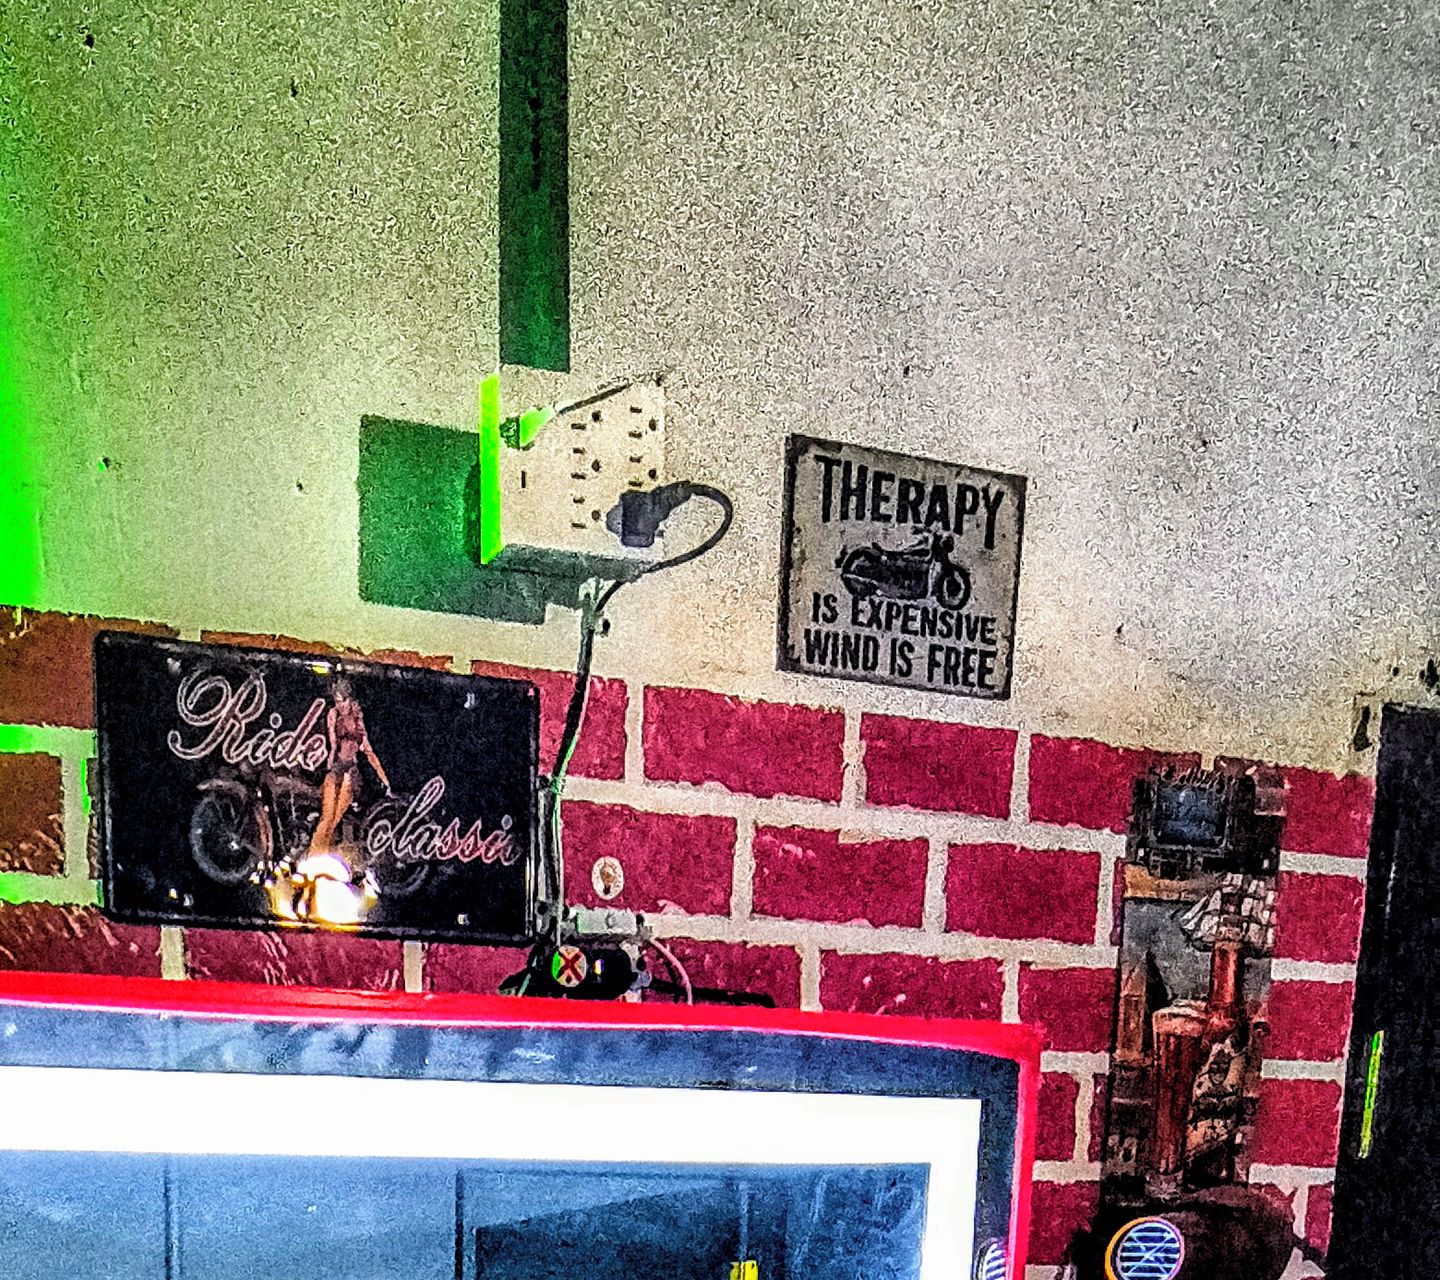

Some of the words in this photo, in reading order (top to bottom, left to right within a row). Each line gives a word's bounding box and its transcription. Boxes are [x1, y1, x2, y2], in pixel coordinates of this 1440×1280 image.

[814, 454, 1005, 550] THERAPY
[812, 591, 838, 624] IS
[850, 598, 997, 646] EXPENSIVE
[803, 627, 880, 672] WIND
[890, 638, 915, 678] IS
[927, 643, 998, 690] FREE
[167, 668, 329, 772] Ride
